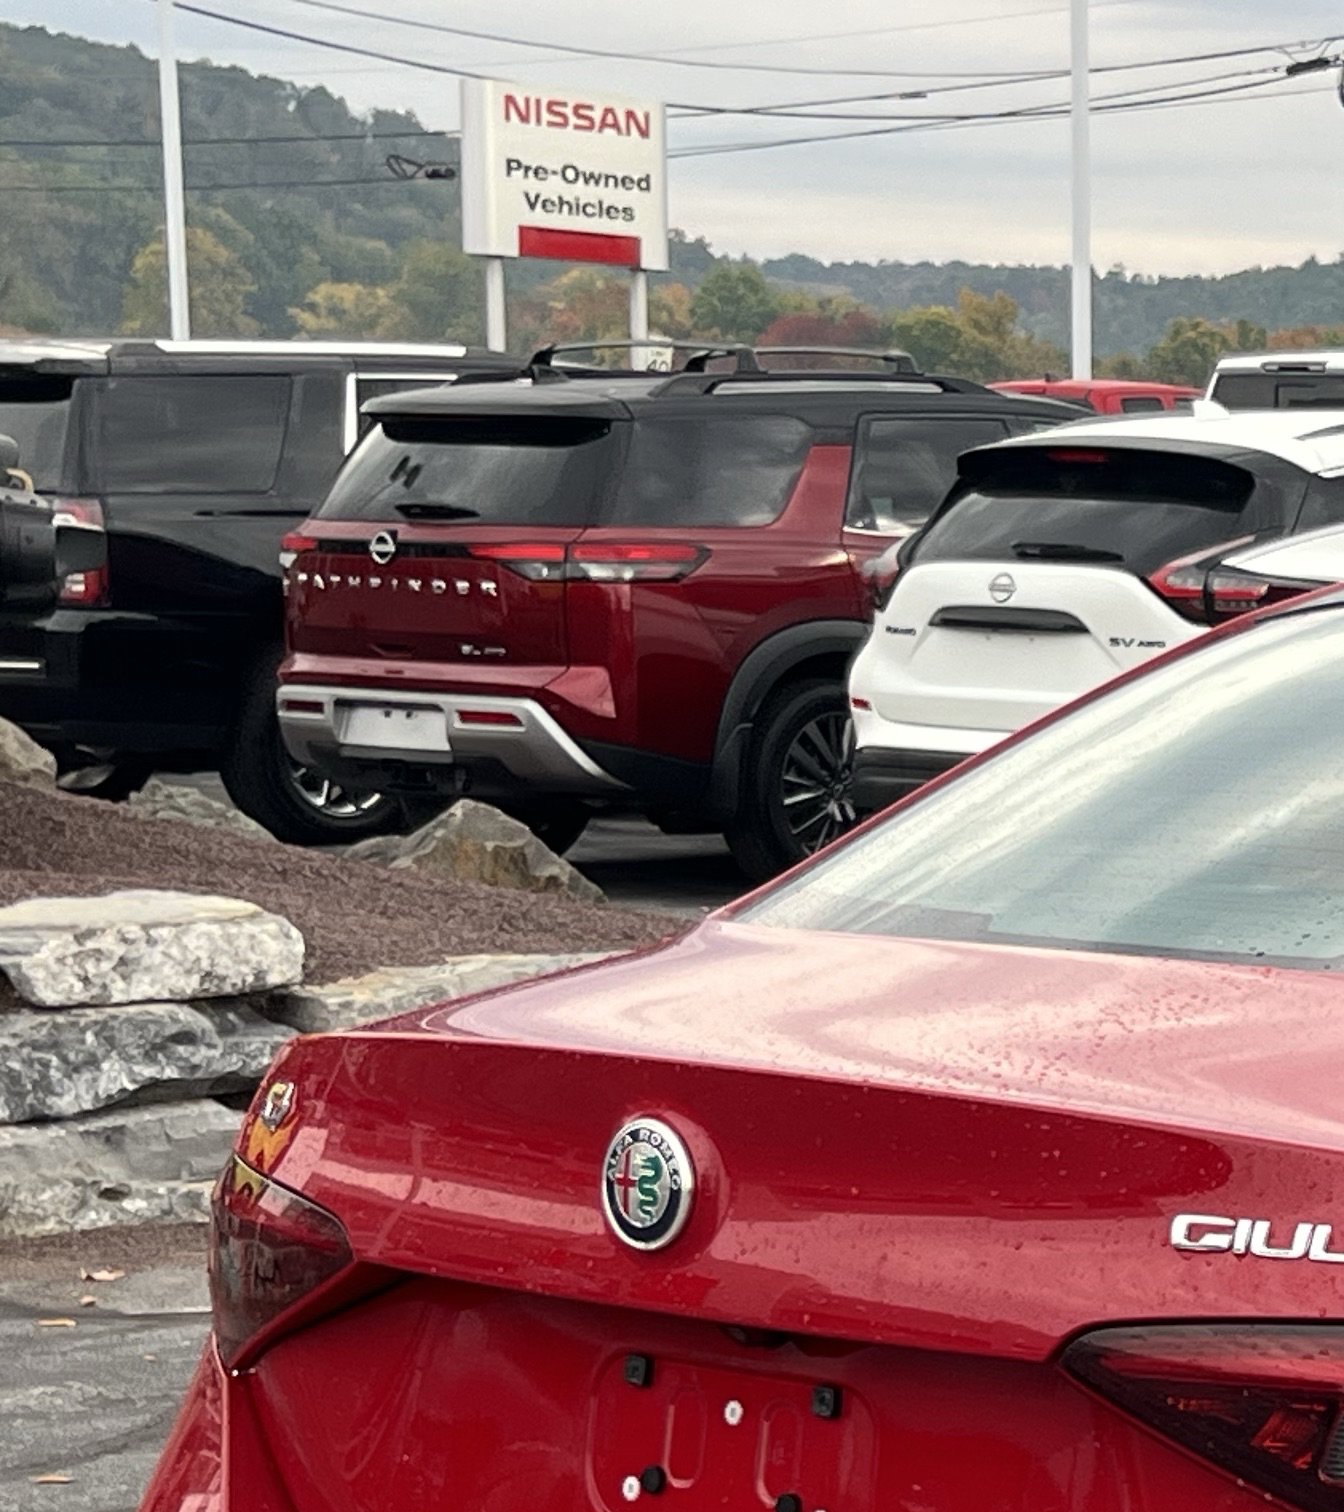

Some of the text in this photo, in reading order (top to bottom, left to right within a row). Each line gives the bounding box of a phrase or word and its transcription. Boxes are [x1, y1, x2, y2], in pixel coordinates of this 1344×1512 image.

[503, 93, 651, 140] NISSAN
[505, 158, 651, 192] Pre-Owned
[523, 191, 636, 222] Vehicles
[639, 1128, 682, 1190] ROMEO
